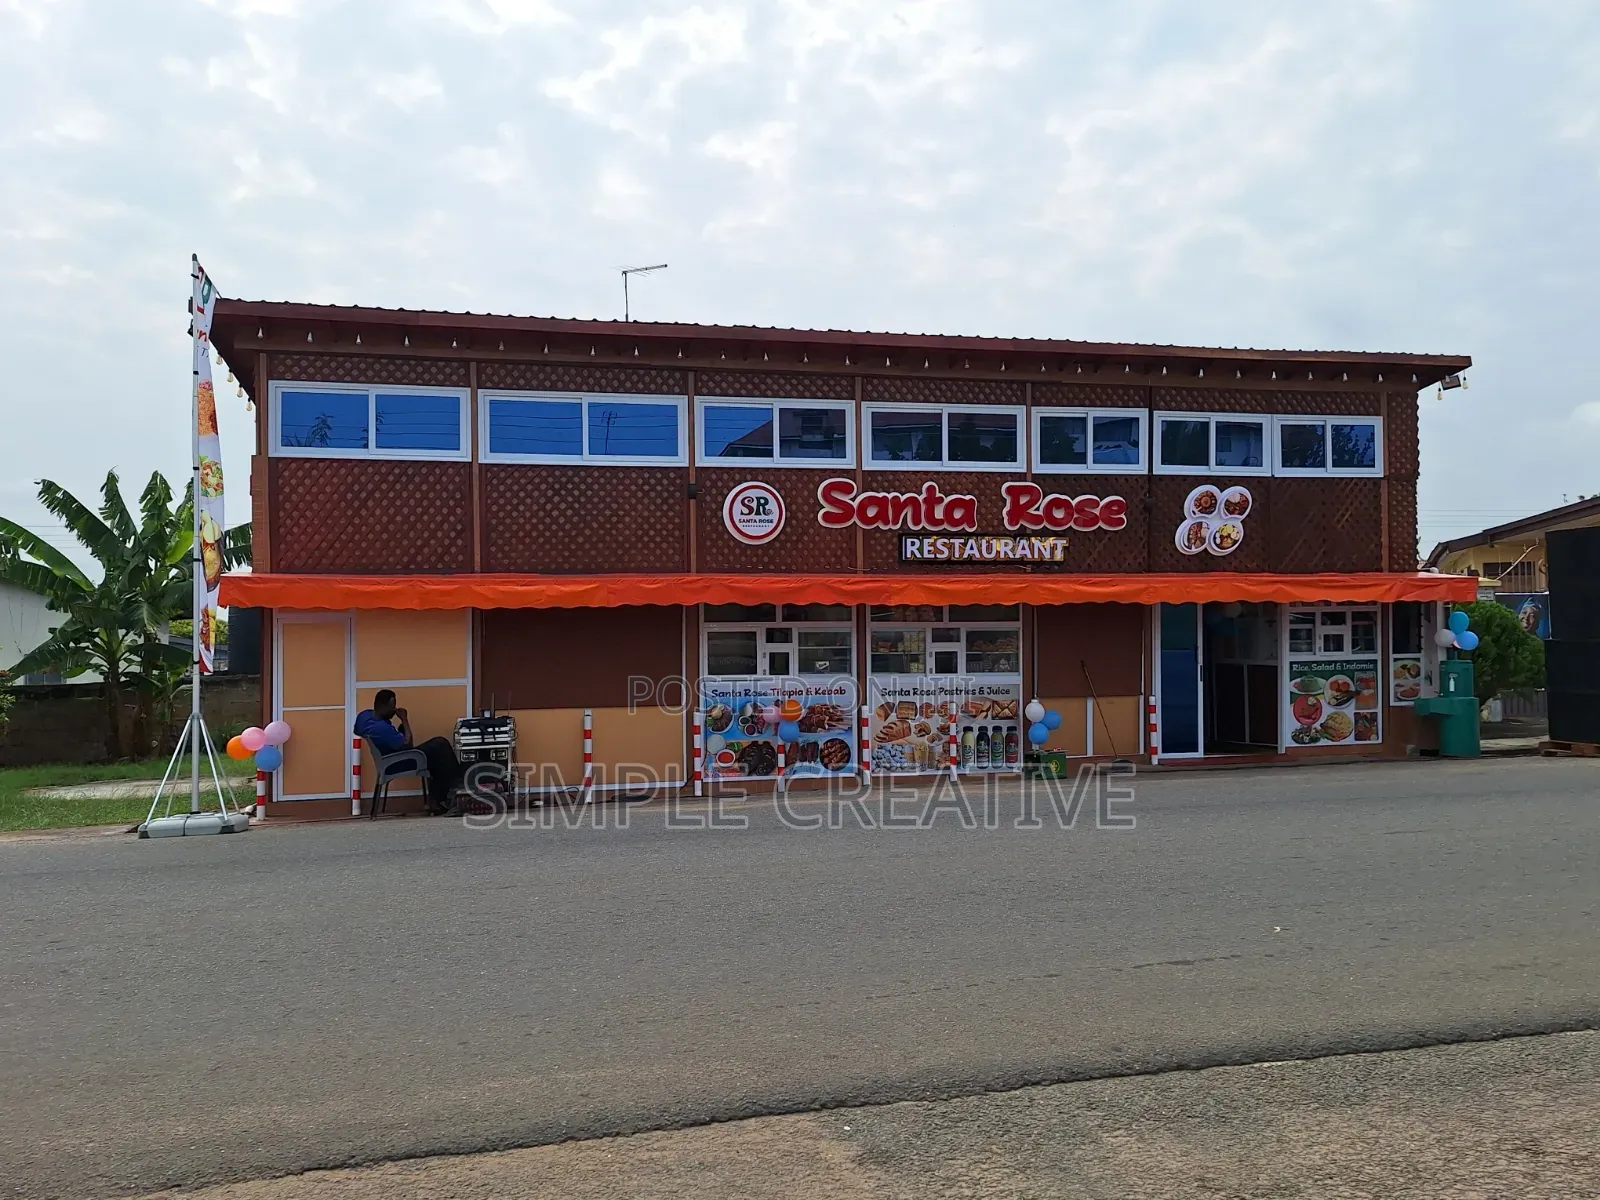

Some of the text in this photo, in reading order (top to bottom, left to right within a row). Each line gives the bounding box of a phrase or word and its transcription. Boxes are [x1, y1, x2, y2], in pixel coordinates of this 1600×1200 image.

[740, 496, 774, 516] SR
[818, 478, 1127, 532] Santa Rose
[905, 537, 1067, 560] RESTAURANT
[1311, 663, 1335, 671] Salad
[1343, 662, 1374, 670] Indomie
[711, 685, 846, 699] Santa Rose Tilapia & Kebab
[880, 686, 1011, 697] Santa Rose Pastries & Juice
